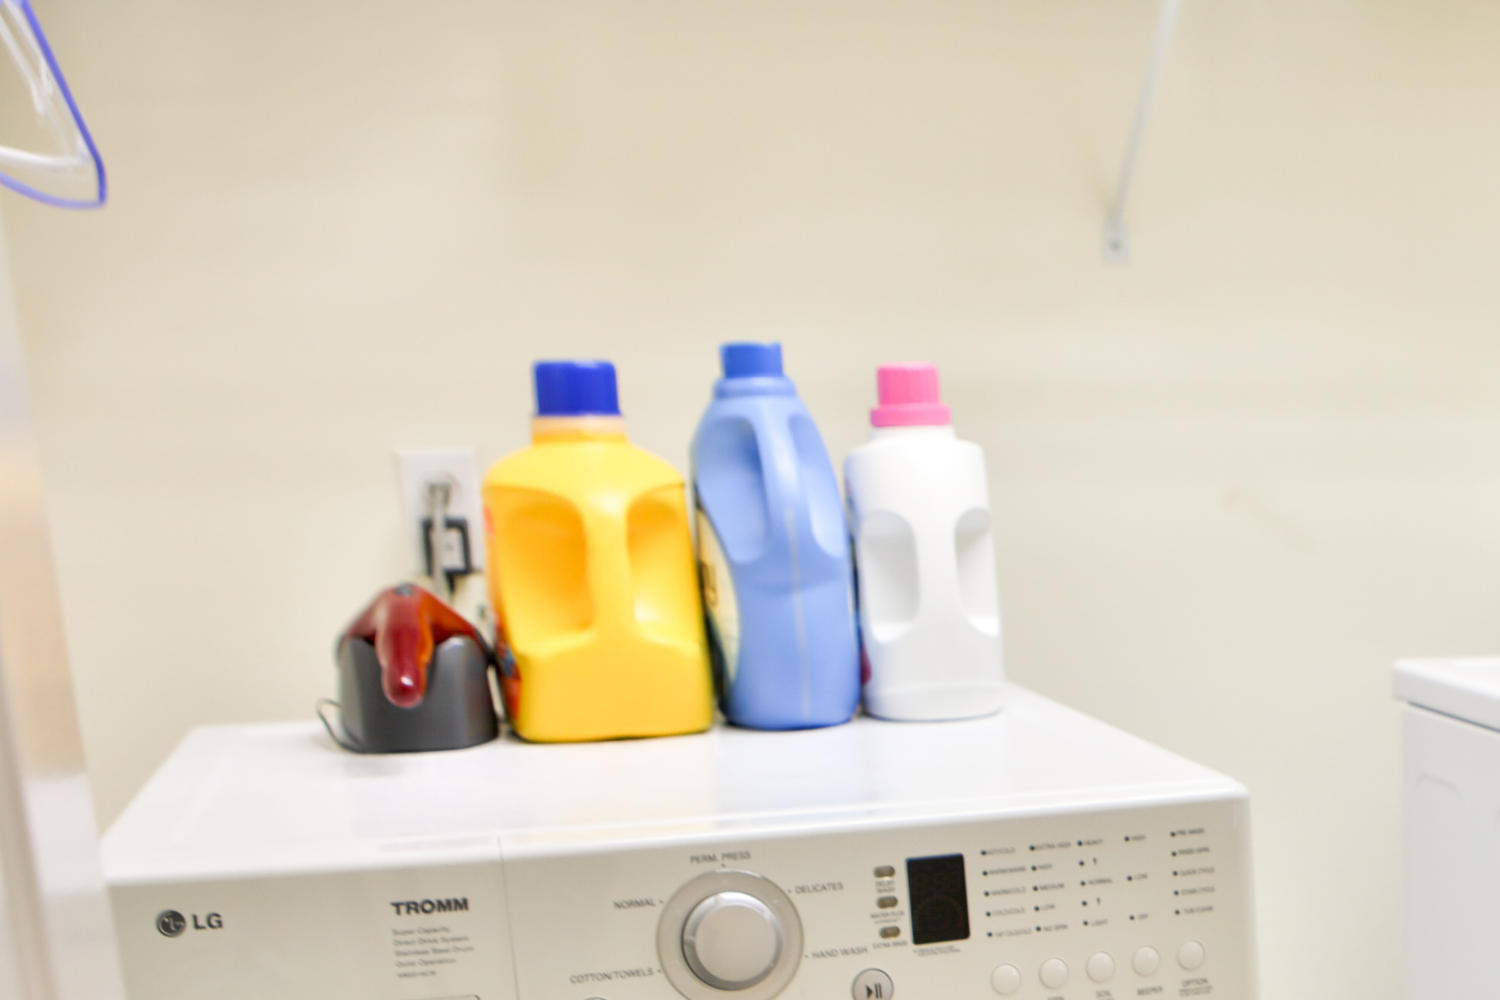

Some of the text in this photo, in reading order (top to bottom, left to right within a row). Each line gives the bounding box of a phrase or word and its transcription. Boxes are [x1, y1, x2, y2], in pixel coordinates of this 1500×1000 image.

[721, 850, 751, 861] PRESS
[794, 881, 845, 895] DELICATES
[389, 897, 470, 916] TROMM
[613, 898, 656, 910] NORMAL
[192, 912, 224, 930] LG
